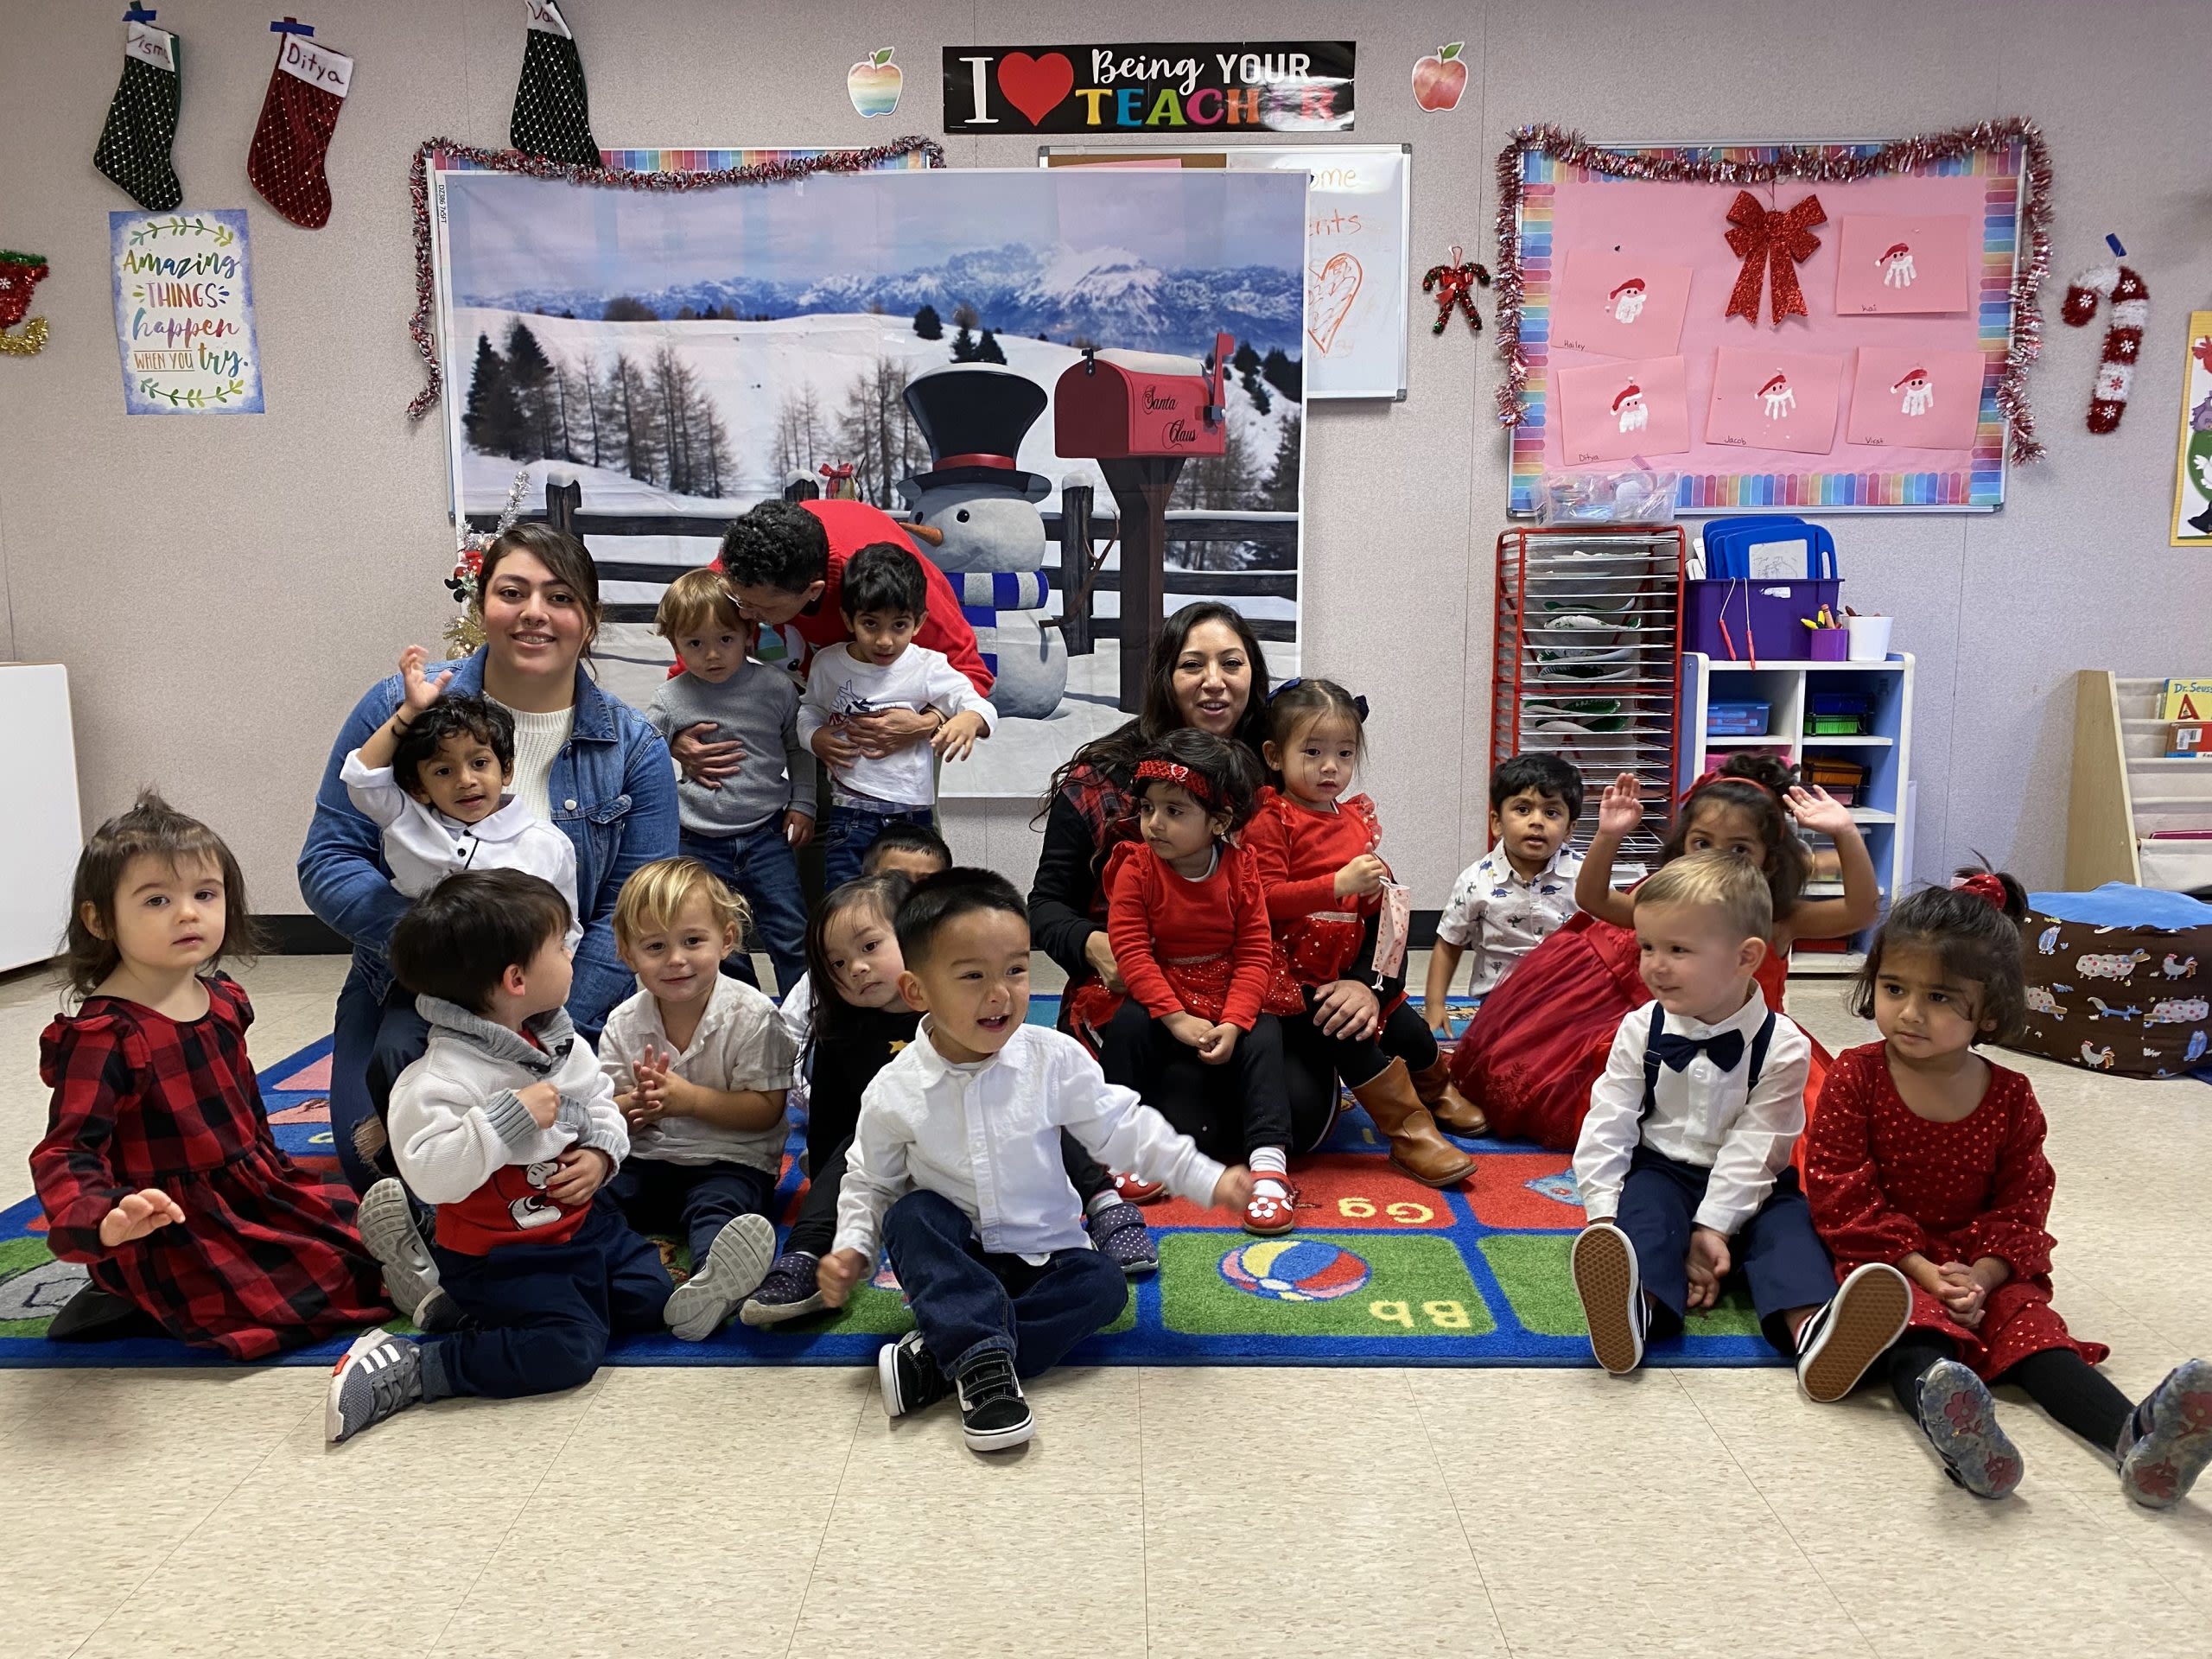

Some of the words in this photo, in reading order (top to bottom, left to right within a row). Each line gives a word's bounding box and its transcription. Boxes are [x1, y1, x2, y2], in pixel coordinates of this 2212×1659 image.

[286, 42, 344, 85] Ditya
[959, 57, 999, 124] I
[1092, 48, 1205, 96] Being
[1216, 53, 1311, 84] YOUR
[123, 249, 240, 279] Amazing
[145, 282, 219, 308] THINGS
[132, 307, 240, 349] happen
[134, 353, 166, 370] WHEN
[169, 353, 194, 370] YOU
[198, 342, 249, 378] try.
[1564, 339, 1586, 352] Hailey
[1141, 385, 1179, 415] Santa
[1162, 418, 1198, 450] Claus
[1724, 435, 1747, 446] Jacob
[1579, 453, 1599, 462] Ditya
[2174, 683, 2188, 694] Dr.
